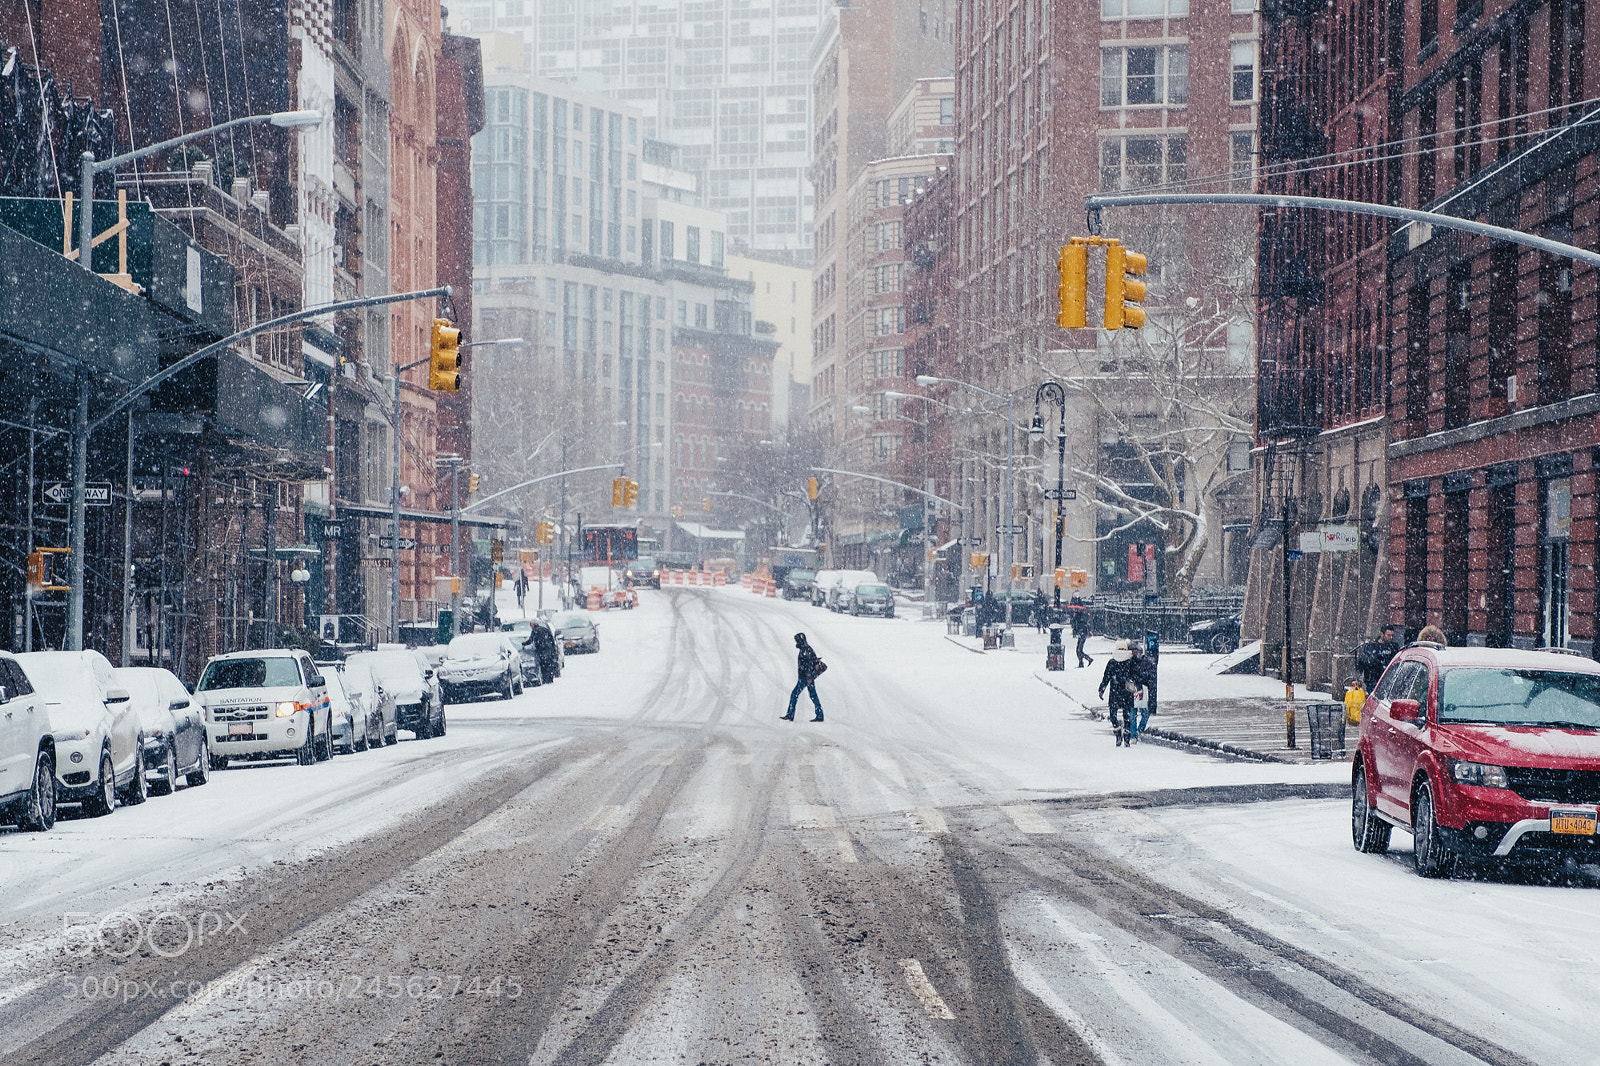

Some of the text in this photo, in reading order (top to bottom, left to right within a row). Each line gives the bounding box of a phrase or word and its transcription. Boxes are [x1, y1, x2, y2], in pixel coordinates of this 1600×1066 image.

[52, 488, 72, 498] ONE
[324, 525, 341, 537] MR
[382, 559, 389, 567] ST
[220, 697, 262, 705] SANITATION
